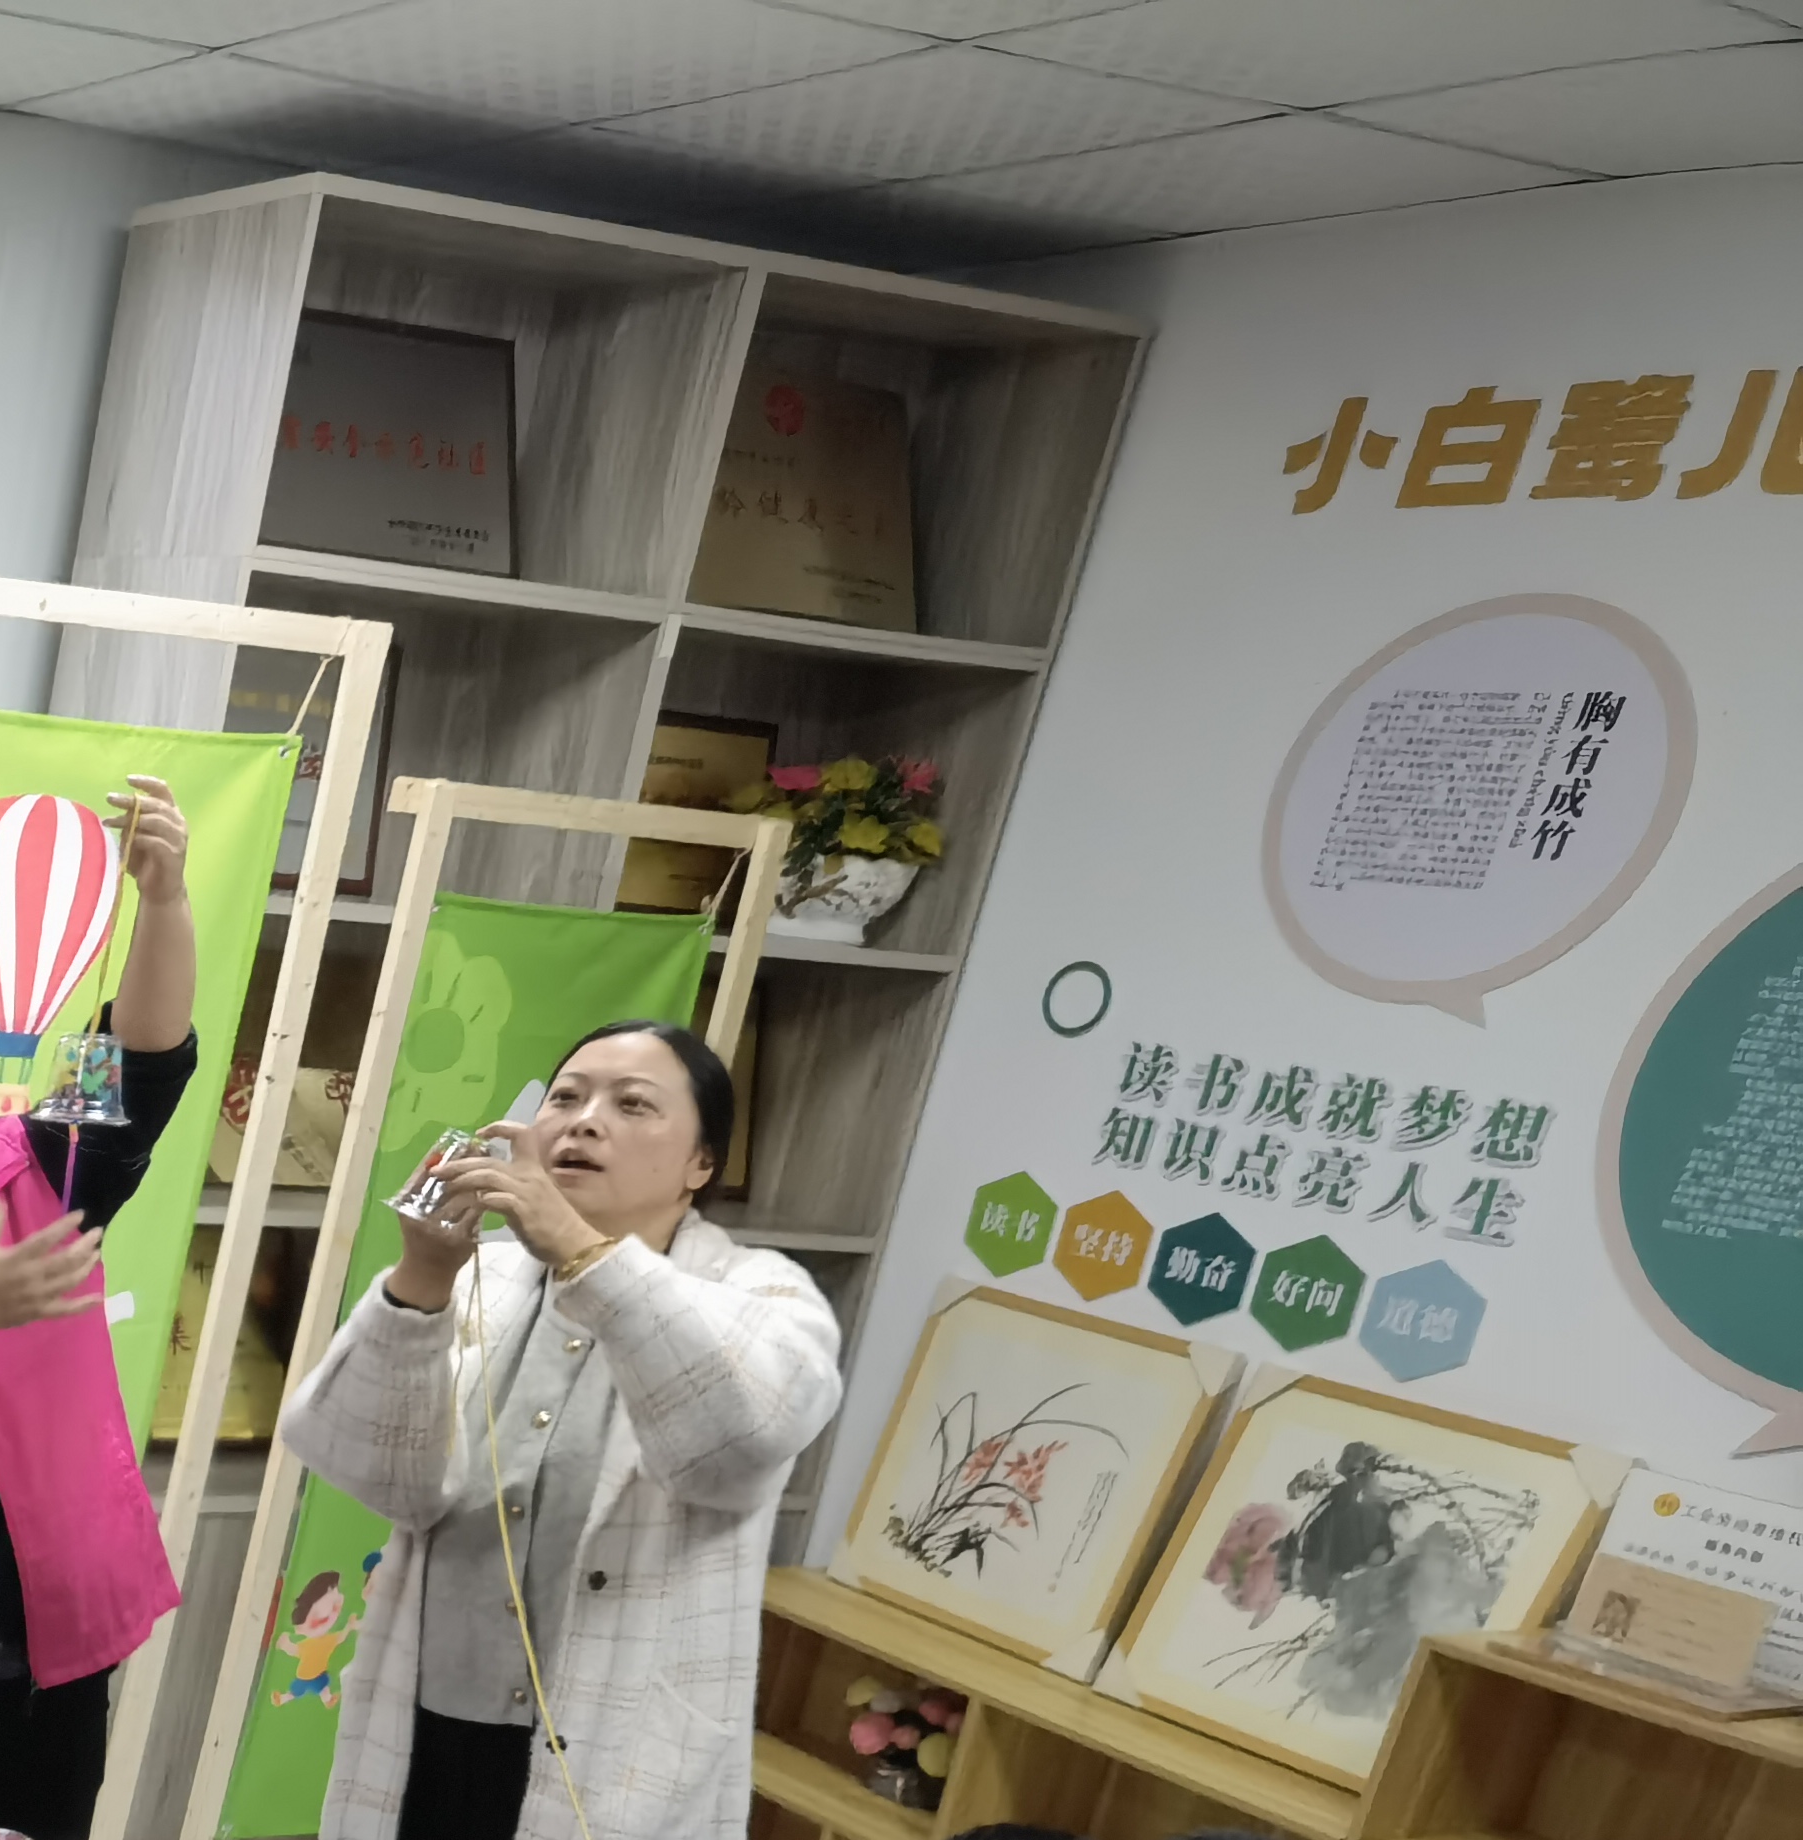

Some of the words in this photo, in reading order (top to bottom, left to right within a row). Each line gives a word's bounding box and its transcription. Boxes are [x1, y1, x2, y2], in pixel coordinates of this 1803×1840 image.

[1530, 690, 1627, 861] 胸有成竹
[1117, 1040, 1559, 1170] 读书成就梦想
[1092, 1105, 1526, 1249] 知识点亮人生
[1164, 1245, 1238, 1293] 勤奋
[1270, 1268, 1346, 1319] 好问
